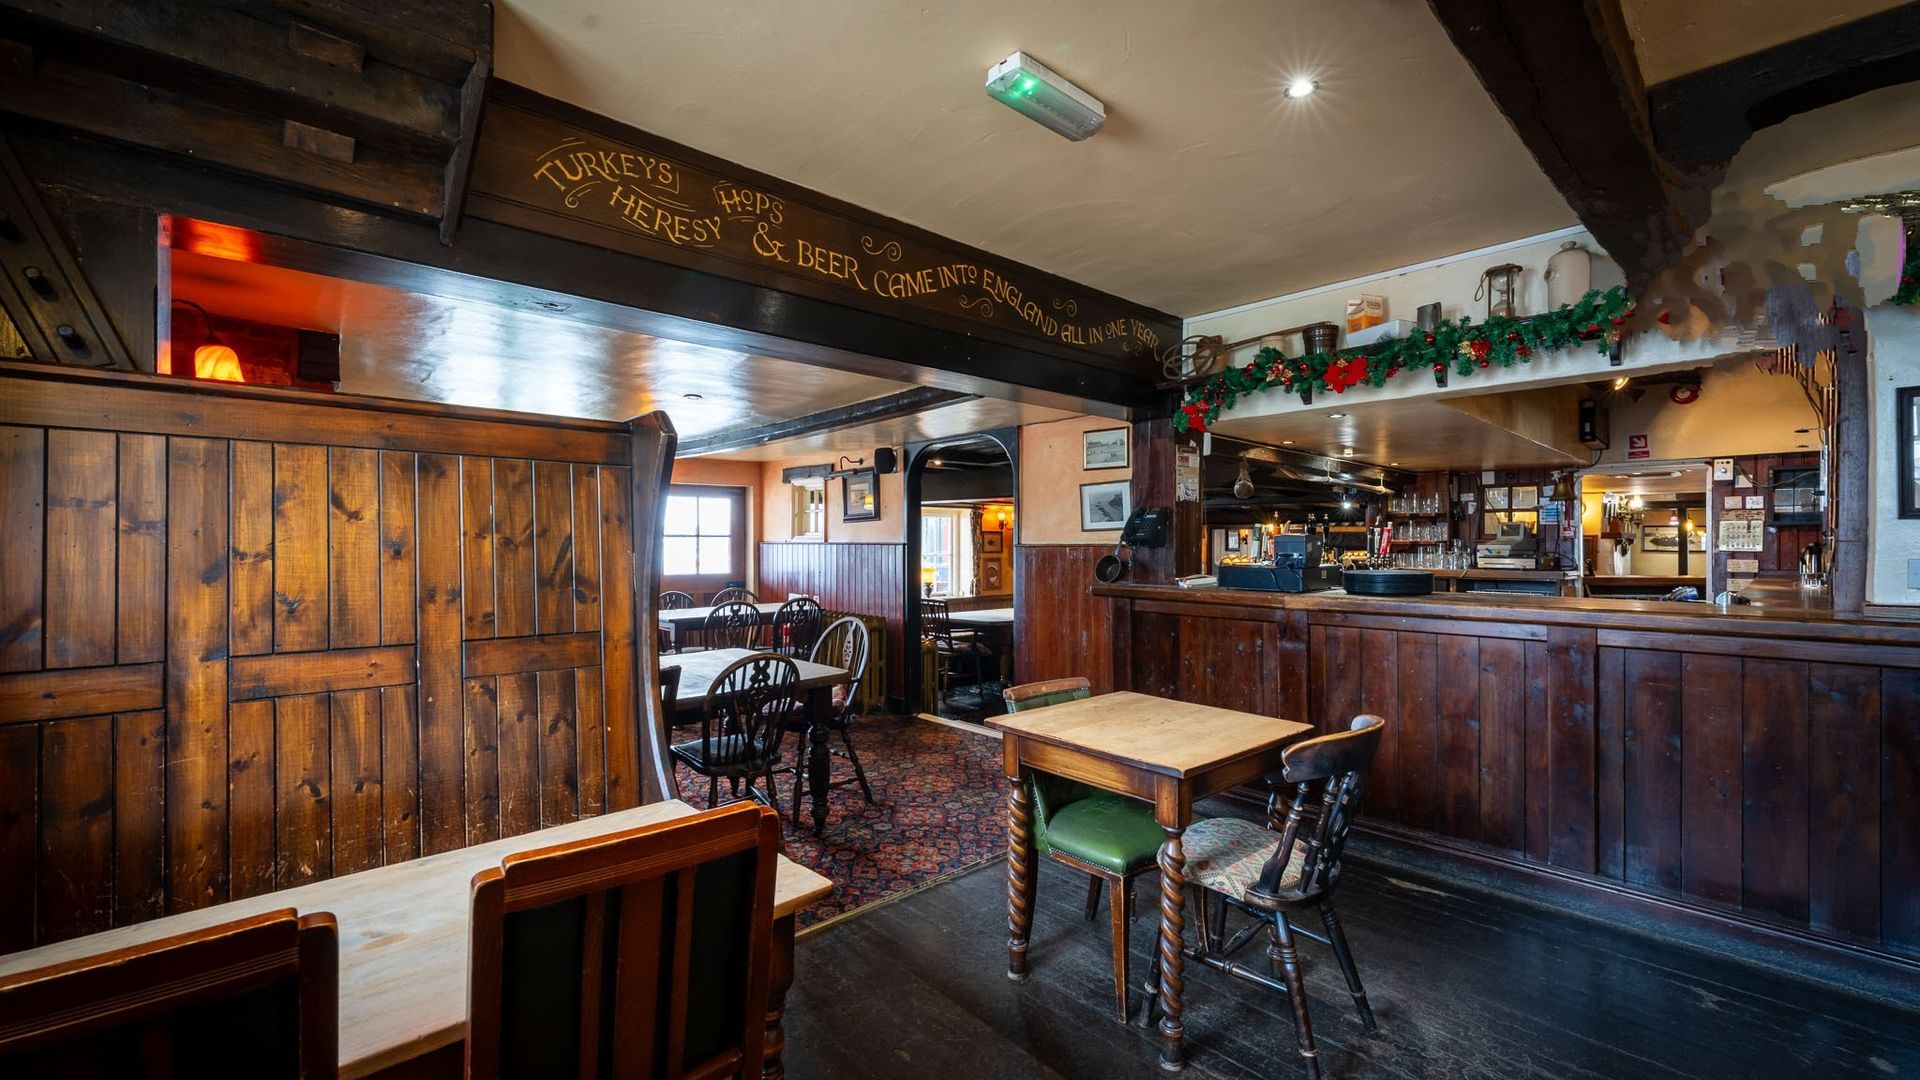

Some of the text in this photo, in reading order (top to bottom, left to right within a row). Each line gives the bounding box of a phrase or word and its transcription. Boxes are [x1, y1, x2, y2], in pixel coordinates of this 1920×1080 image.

[533, 151, 673, 191] TURKEYS
[609, 186, 721, 244] HERESY
[718, 189, 784, 224] HOPS
[753, 222, 790, 262] &
[797, 239, 868, 290] BEER
[873, 268, 937, 299] CAME
[982, 270, 1058, 337] ENGLAND
[1061, 324, 1086, 345] ALL
[1088, 326, 1103, 344] IN
[1131, 319, 1160, 361] YEAR
